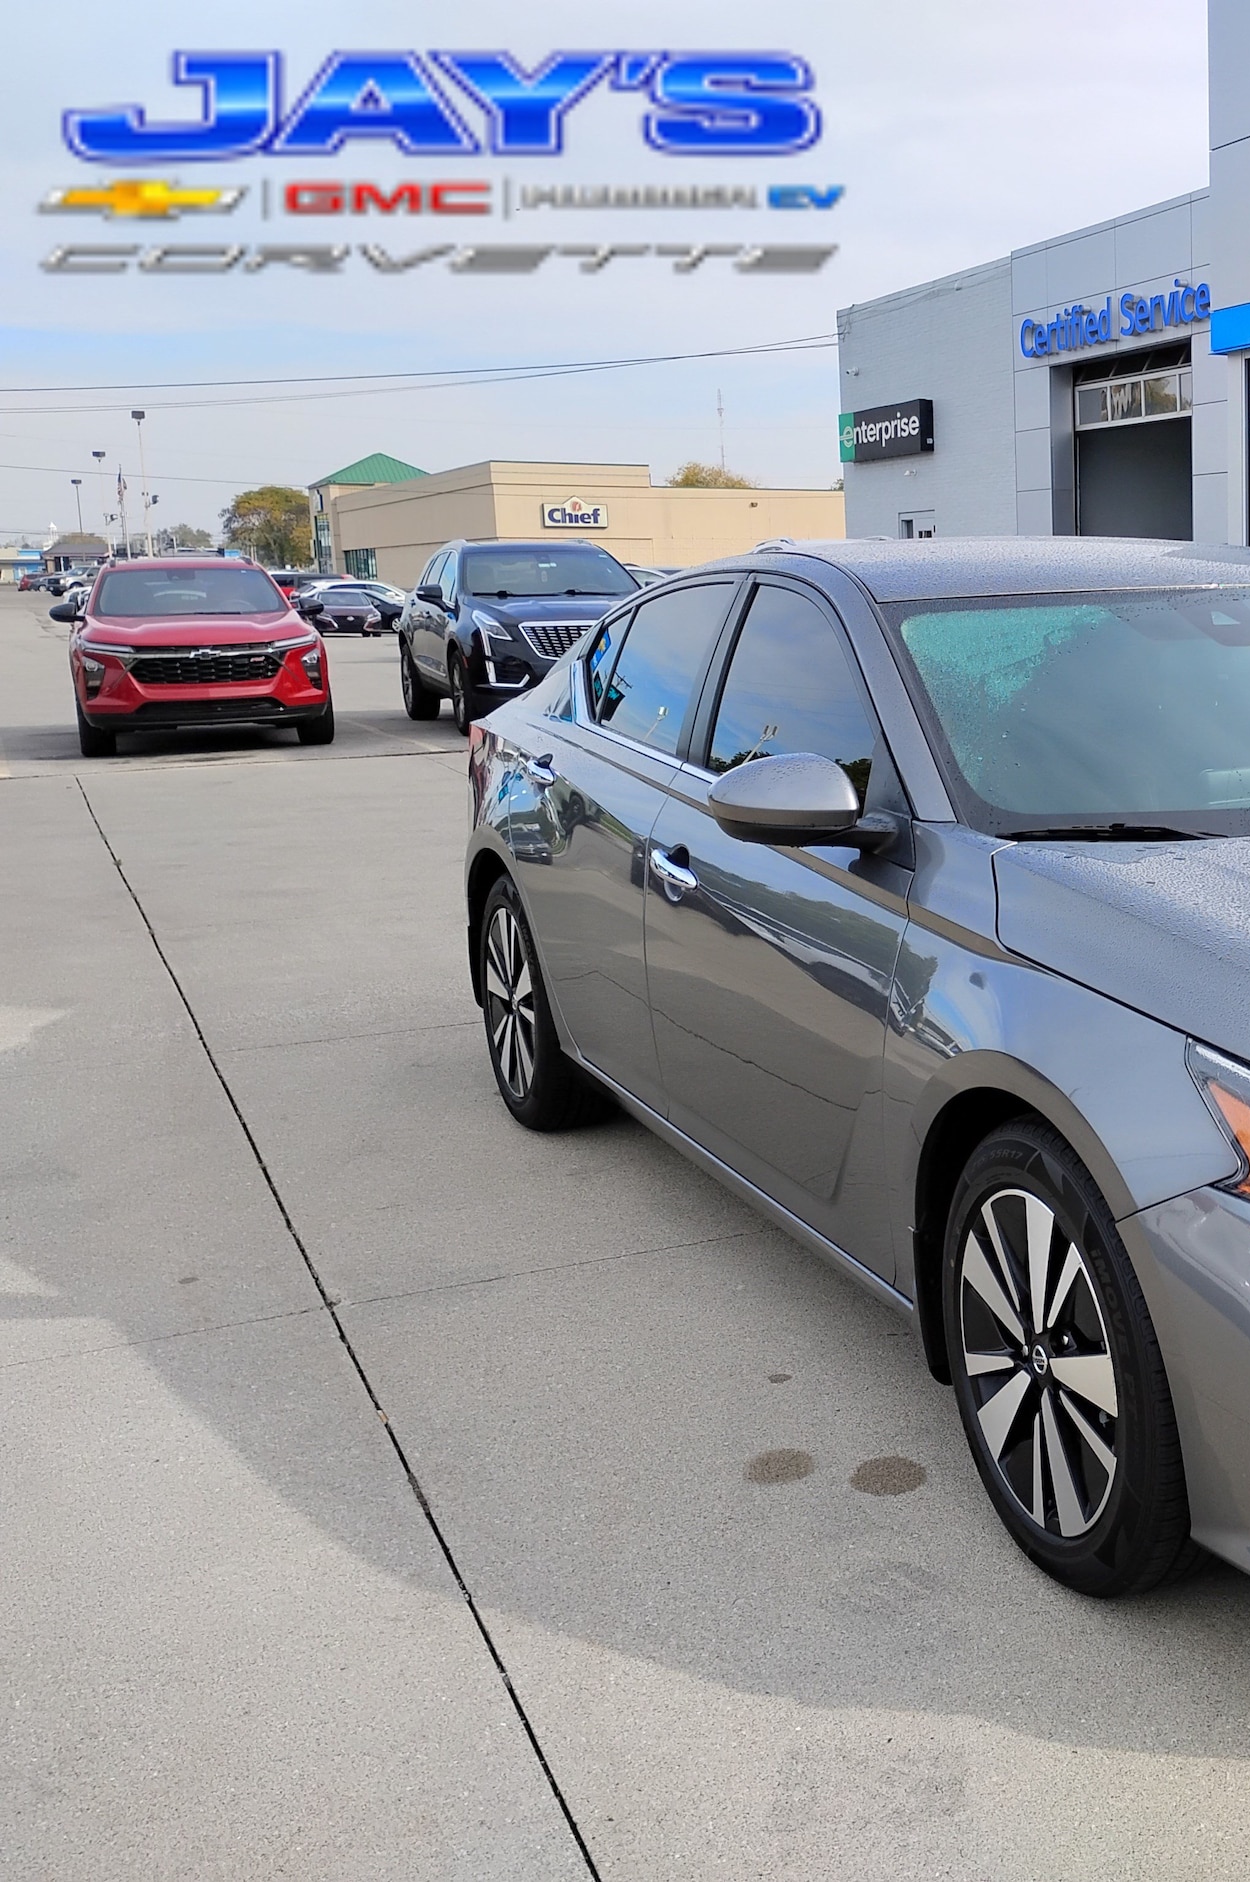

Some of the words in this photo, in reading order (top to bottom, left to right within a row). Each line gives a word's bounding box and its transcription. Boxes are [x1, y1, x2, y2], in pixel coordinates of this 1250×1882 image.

[1020, 296, 1113, 359] Certified
[1119, 278, 1210, 337] Service
[839, 411, 920, 447] enterprise
[547, 507, 601, 524] Chief
